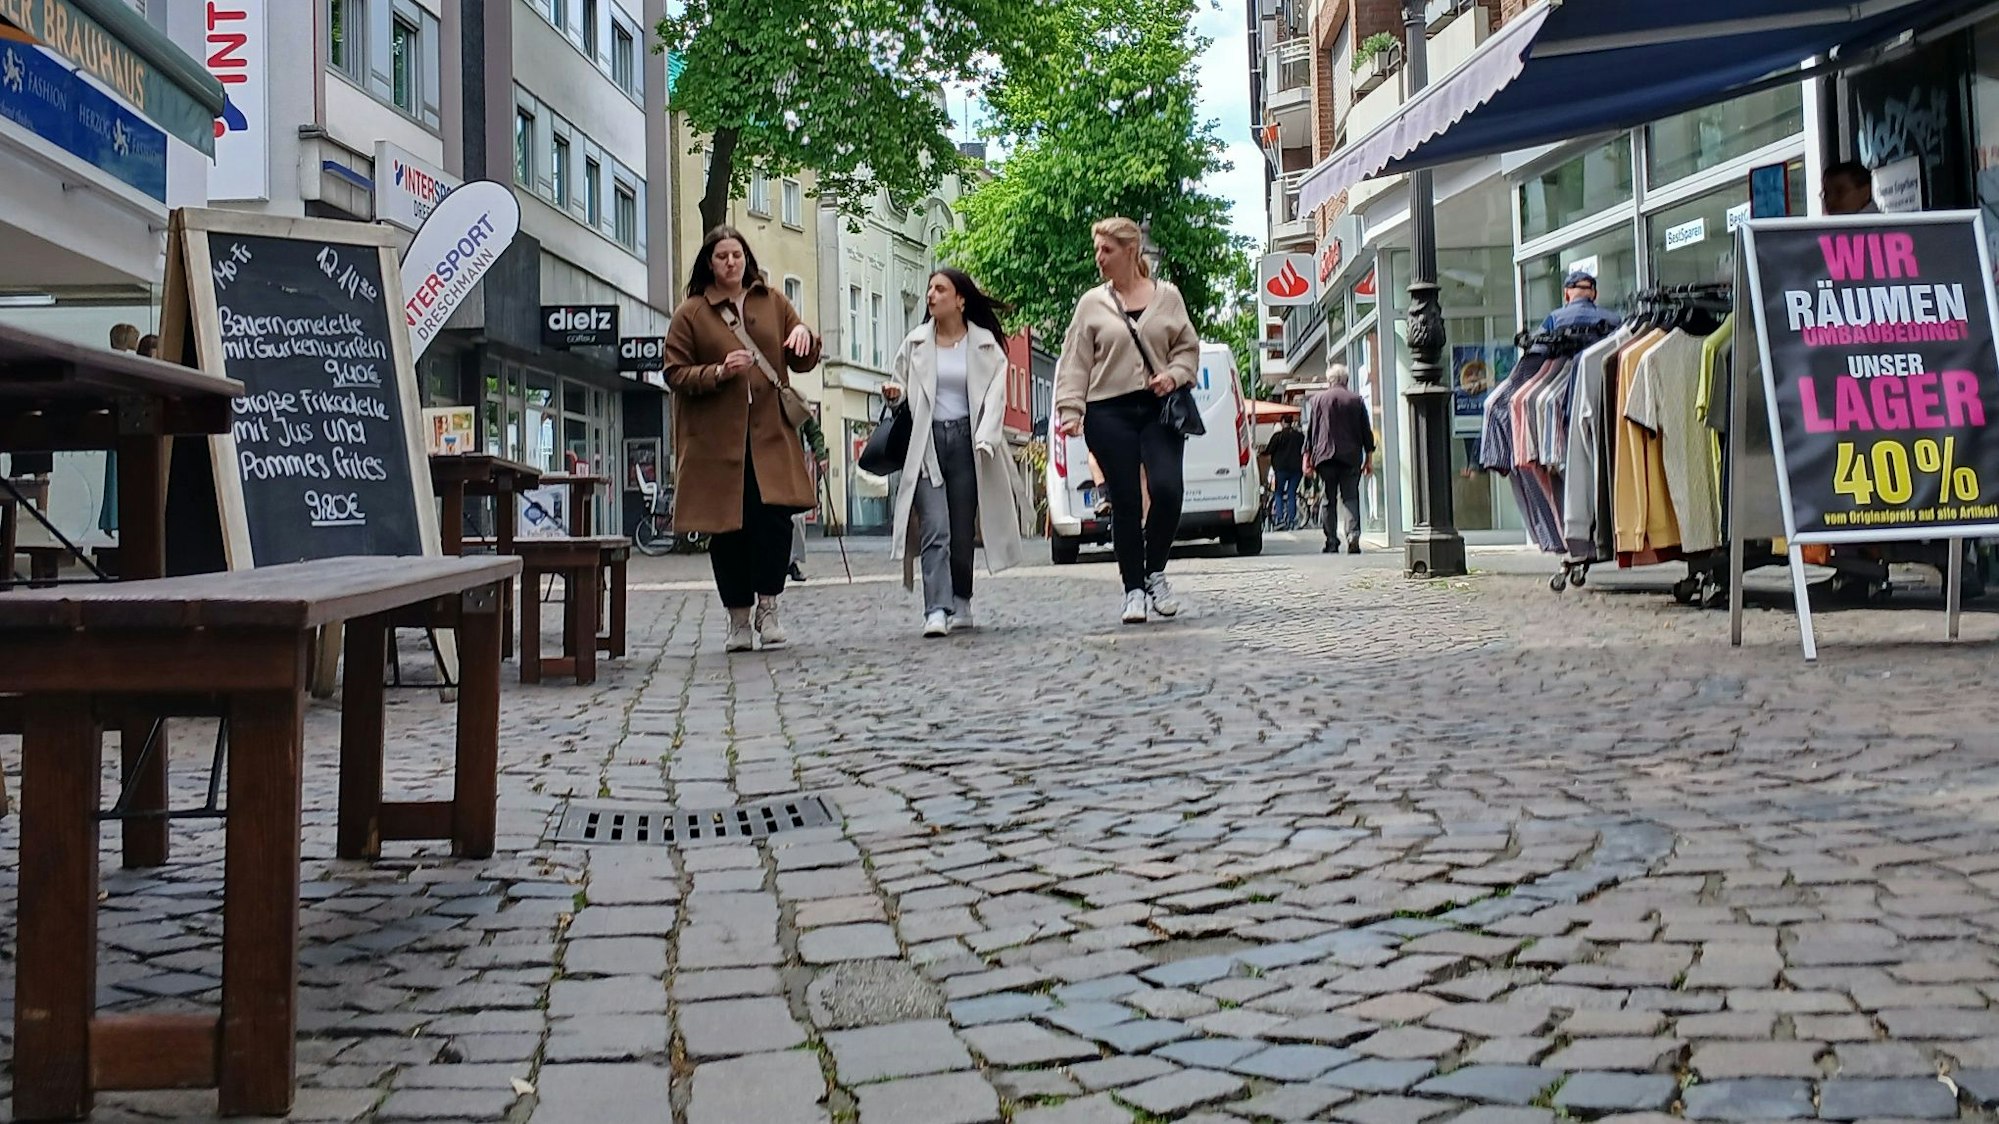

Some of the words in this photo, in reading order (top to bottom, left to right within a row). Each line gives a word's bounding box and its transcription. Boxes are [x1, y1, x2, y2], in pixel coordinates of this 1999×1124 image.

[44, 0, 144, 110] BRAUHAUS
[207, 1, 248, 84] INT
[27, 71, 67, 112] FASHION
[1668, 225, 1703, 246] BestSparen
[1818, 232, 1919, 281] WIR
[417, 248, 495, 341] DRESCHMANN
[1784, 279, 1968, 331] RÄUMEN
[217, 305, 364, 337] Bauernomelette
[548, 307, 612, 331] dietz
[1802, 319, 1968, 347] UMBAUBEDINGT
[223, 338, 254, 360] mit
[621, 338, 664, 359] diet
[1847, 353, 1924, 379] UNSER
[300, 389, 389, 421] Frikadelle
[1798, 369, 1986, 434] LAGER
[234, 416, 270, 444] mit
[273, 416, 314, 447] Jus
[240, 450, 330, 481] Pommes
[1833, 436, 1980, 505] 40%
[1824, 512, 1847, 525] vom
[1849, 508, 1917, 525] Originalpreis
[1918, 507, 1935, 522] auf
[1937, 506, 1957, 521] alle
